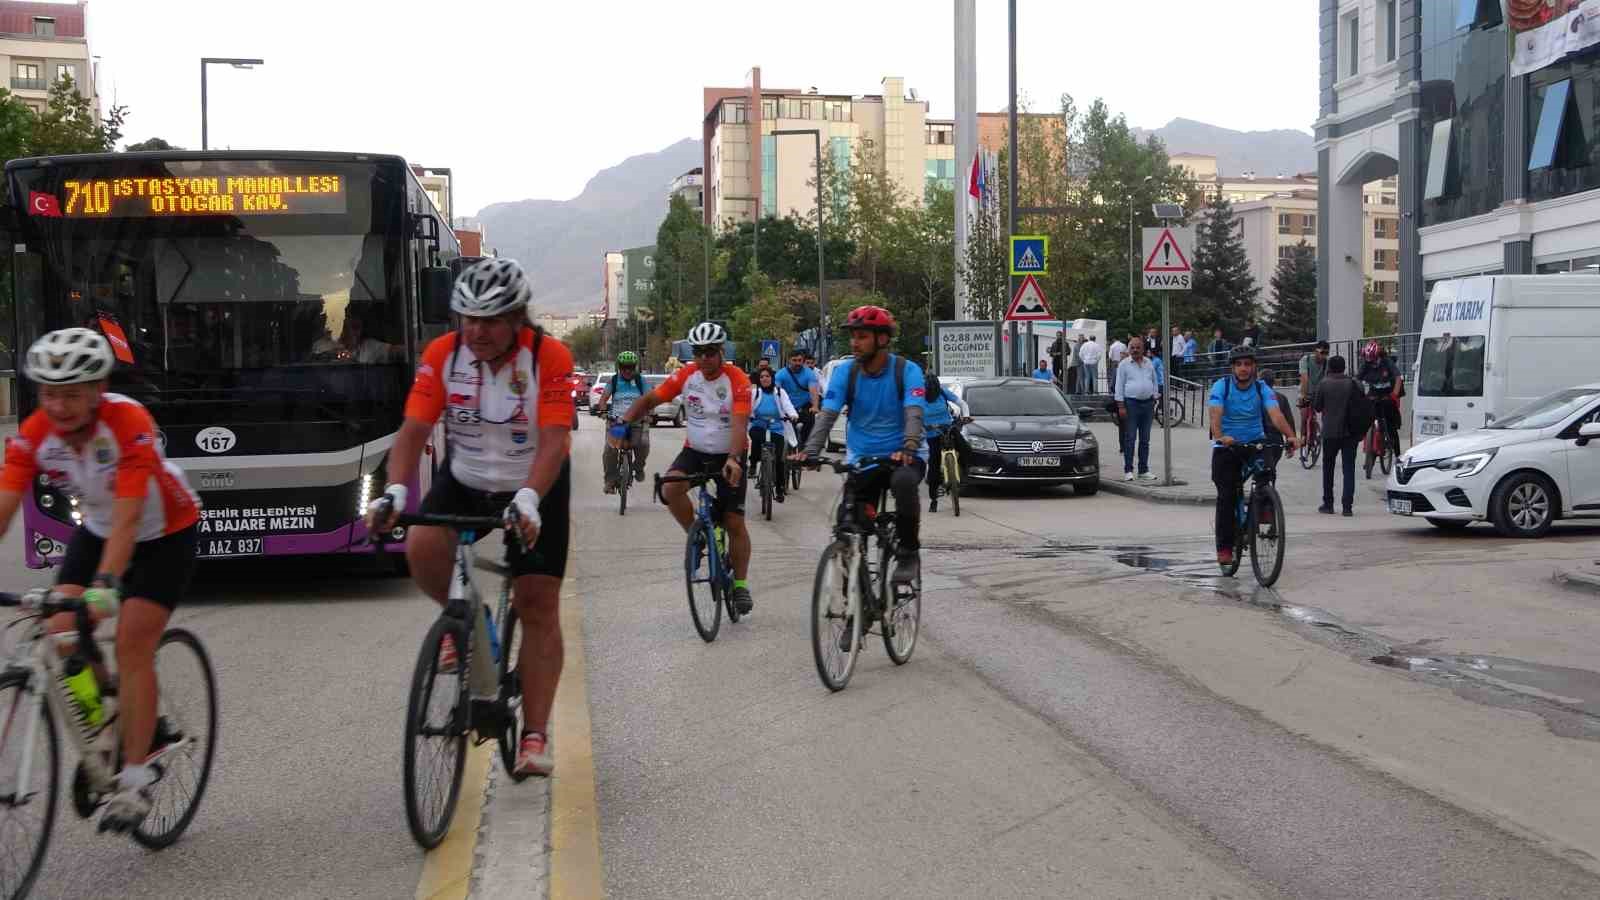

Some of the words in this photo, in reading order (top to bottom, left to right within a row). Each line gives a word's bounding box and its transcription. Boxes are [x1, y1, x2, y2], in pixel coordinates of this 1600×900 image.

[64, 182, 110, 214] 710
[151, 194, 234, 212] OTOGAR
[243, 194, 288, 211] KAV.
[1145, 275, 1190, 287] YAVAŞ
[1455, 300, 1485, 320] TARIM
[973, 333, 993, 341] MW
[200, 437, 231, 450] 167
[200, 506, 240, 520] ŞEHİR
[242, 504, 316, 517] BELEDİYESİ
[215, 518, 266, 532] BAJARE
[269, 517, 315, 530] MEZIN
[209, 540, 232, 555] AAZ
[238, 538, 261, 553] 837
